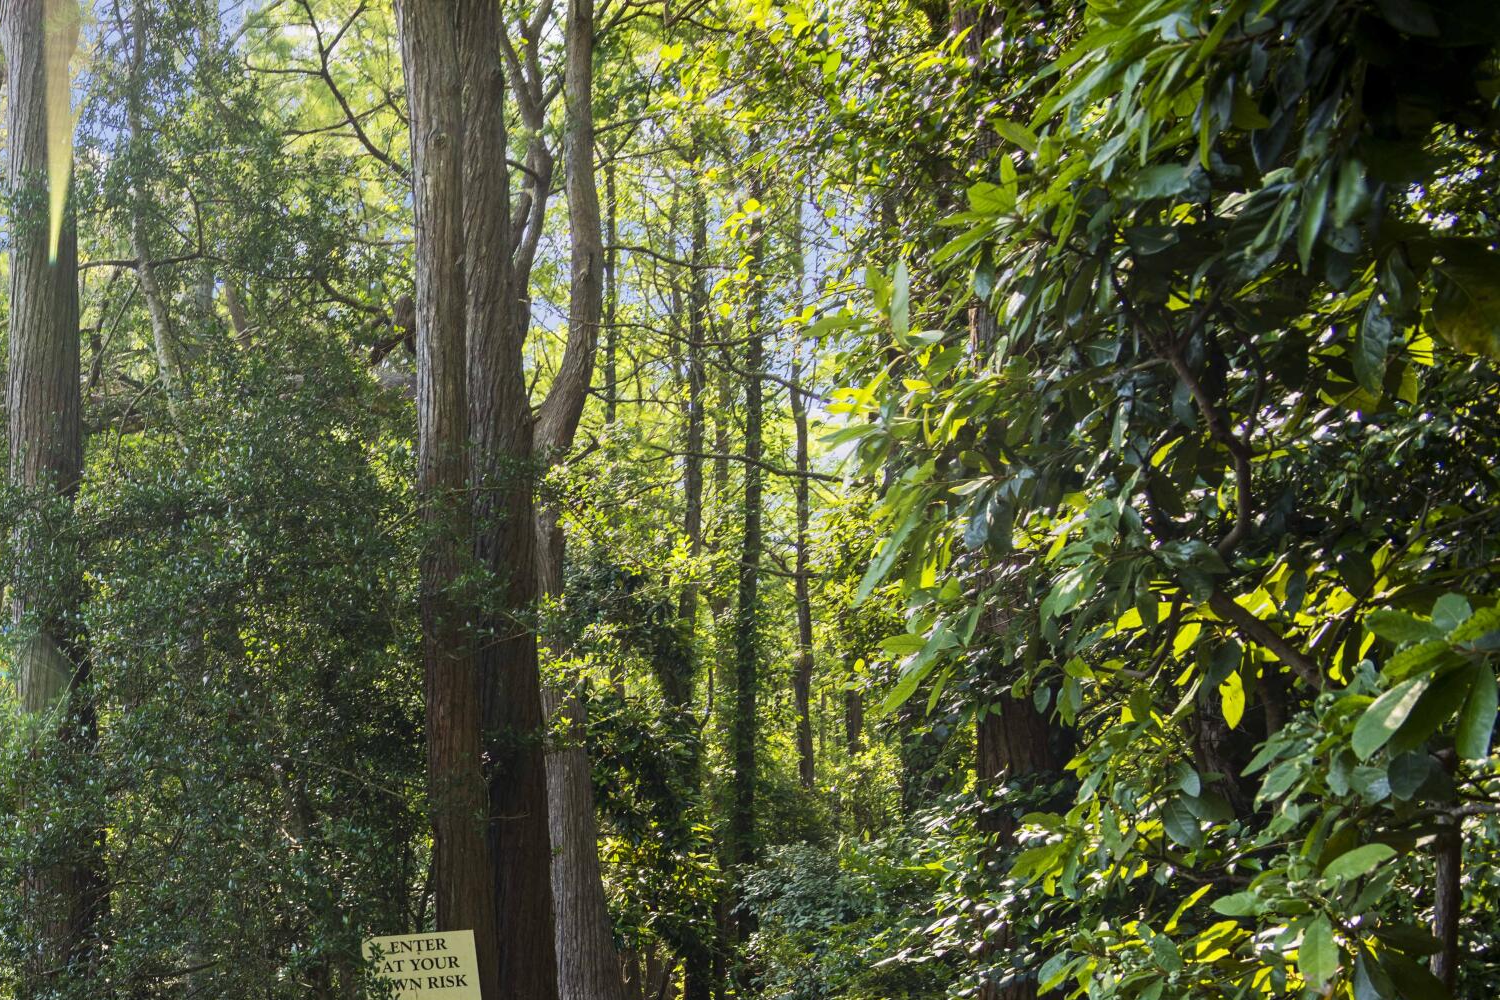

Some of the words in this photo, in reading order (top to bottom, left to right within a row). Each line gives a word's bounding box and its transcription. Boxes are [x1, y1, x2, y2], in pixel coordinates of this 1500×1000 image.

[390, 938, 448, 953] ENTER
[382, 960, 404, 973] AT
[411, 956, 460, 971] YOUR
[387, 978, 422, 991] WN
[427, 974, 468, 989] RISK
